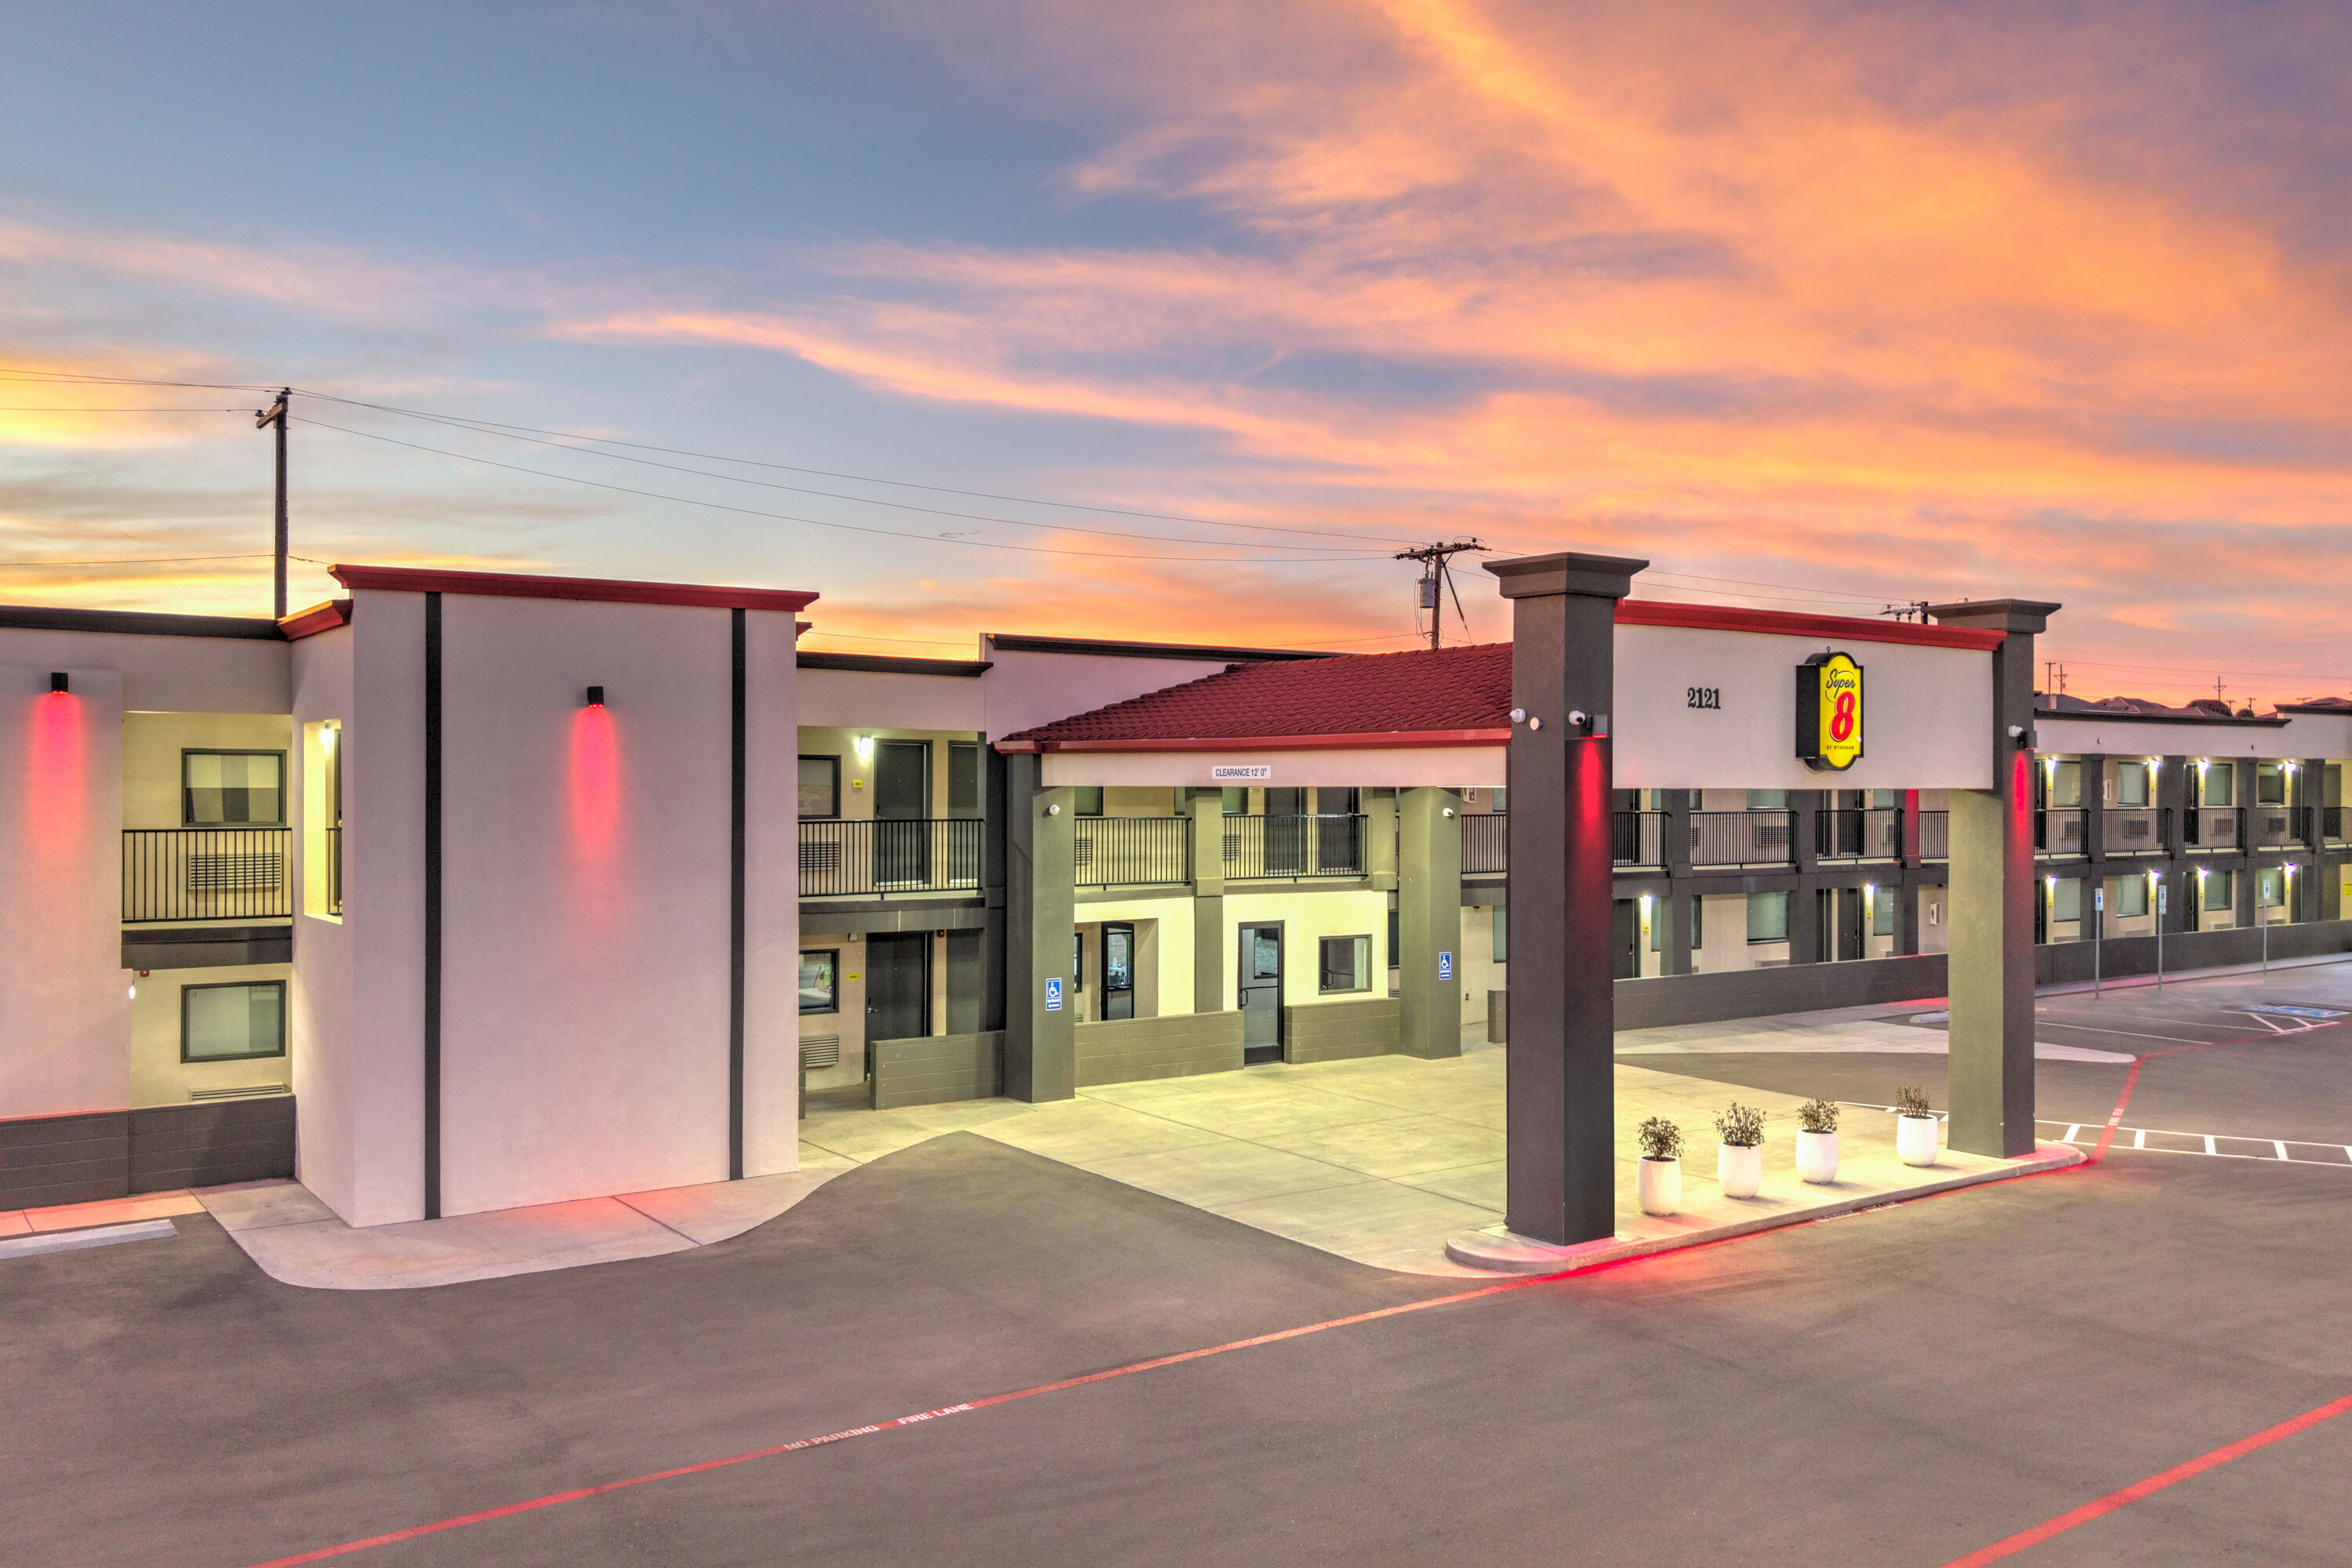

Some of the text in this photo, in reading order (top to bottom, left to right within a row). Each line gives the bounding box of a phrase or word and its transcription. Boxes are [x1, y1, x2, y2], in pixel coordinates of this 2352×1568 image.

[1687, 687, 1721, 710] 2121
[1826, 669, 1856, 699] Super
[1829, 691, 1855, 742] 8
[1215, 768, 1250, 777] CLEARANCE
[784, 1403, 974, 1451] NO PARKING FIRE LANE
